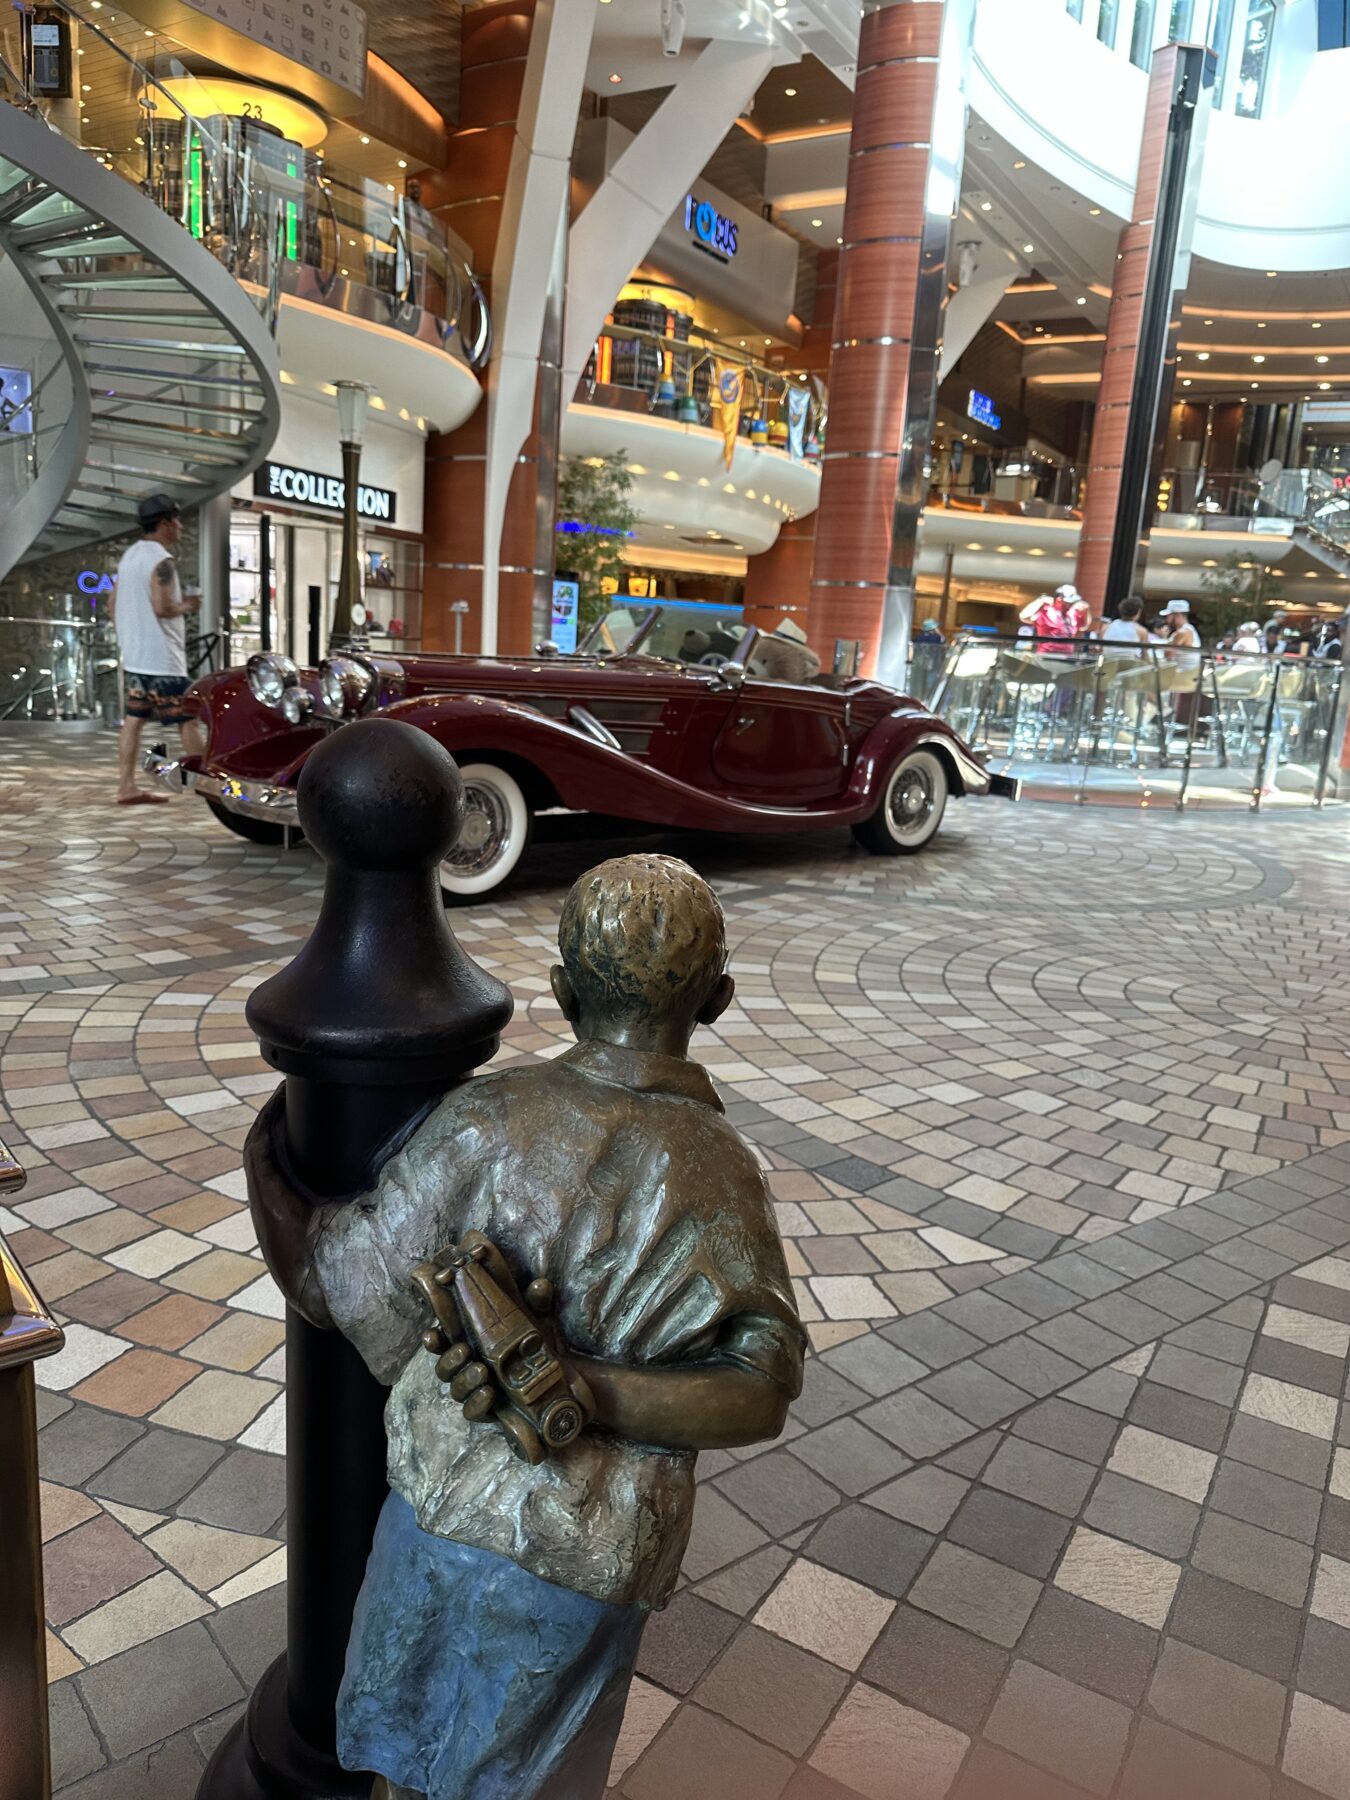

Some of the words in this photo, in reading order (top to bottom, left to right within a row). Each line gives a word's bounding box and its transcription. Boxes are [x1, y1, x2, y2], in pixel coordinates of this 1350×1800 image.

[242, 102, 263, 121] 23
[269, 465, 281, 495] THE
[279, 468, 390, 519] COLLECION
